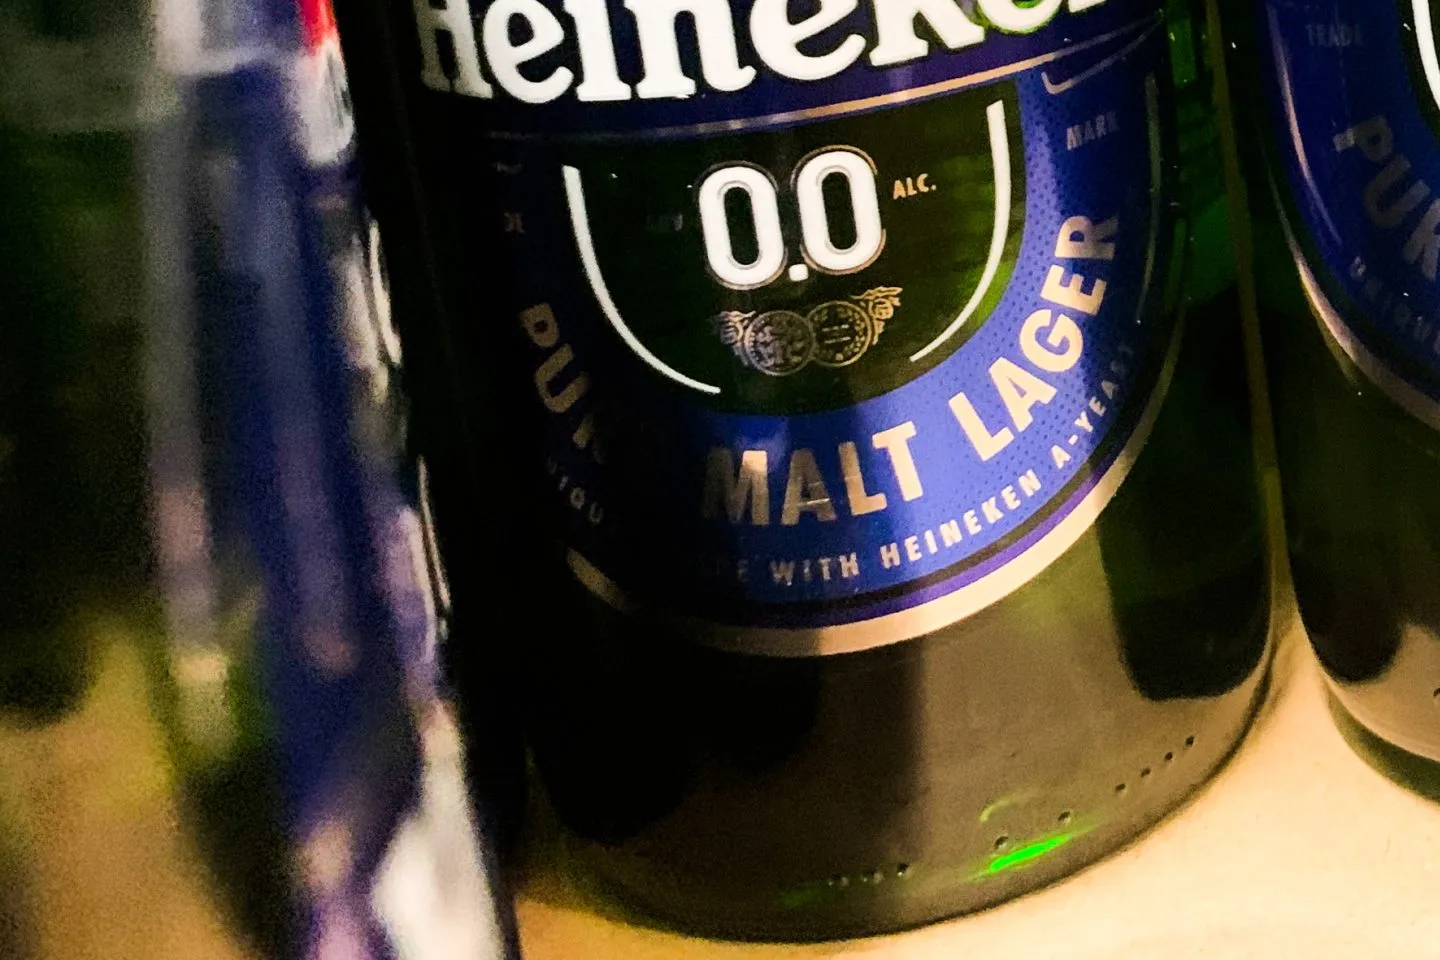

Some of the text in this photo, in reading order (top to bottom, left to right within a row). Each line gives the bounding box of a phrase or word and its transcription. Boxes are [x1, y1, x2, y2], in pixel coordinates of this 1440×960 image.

[695, 147, 937, 289] 0.0 ALC.
[702, 420, 924, 528] MALT
[949, 215, 1120, 461] LAGER
[769, 553, 860, 587] WITH
[880, 468, 1042, 570] HEINEKEN
